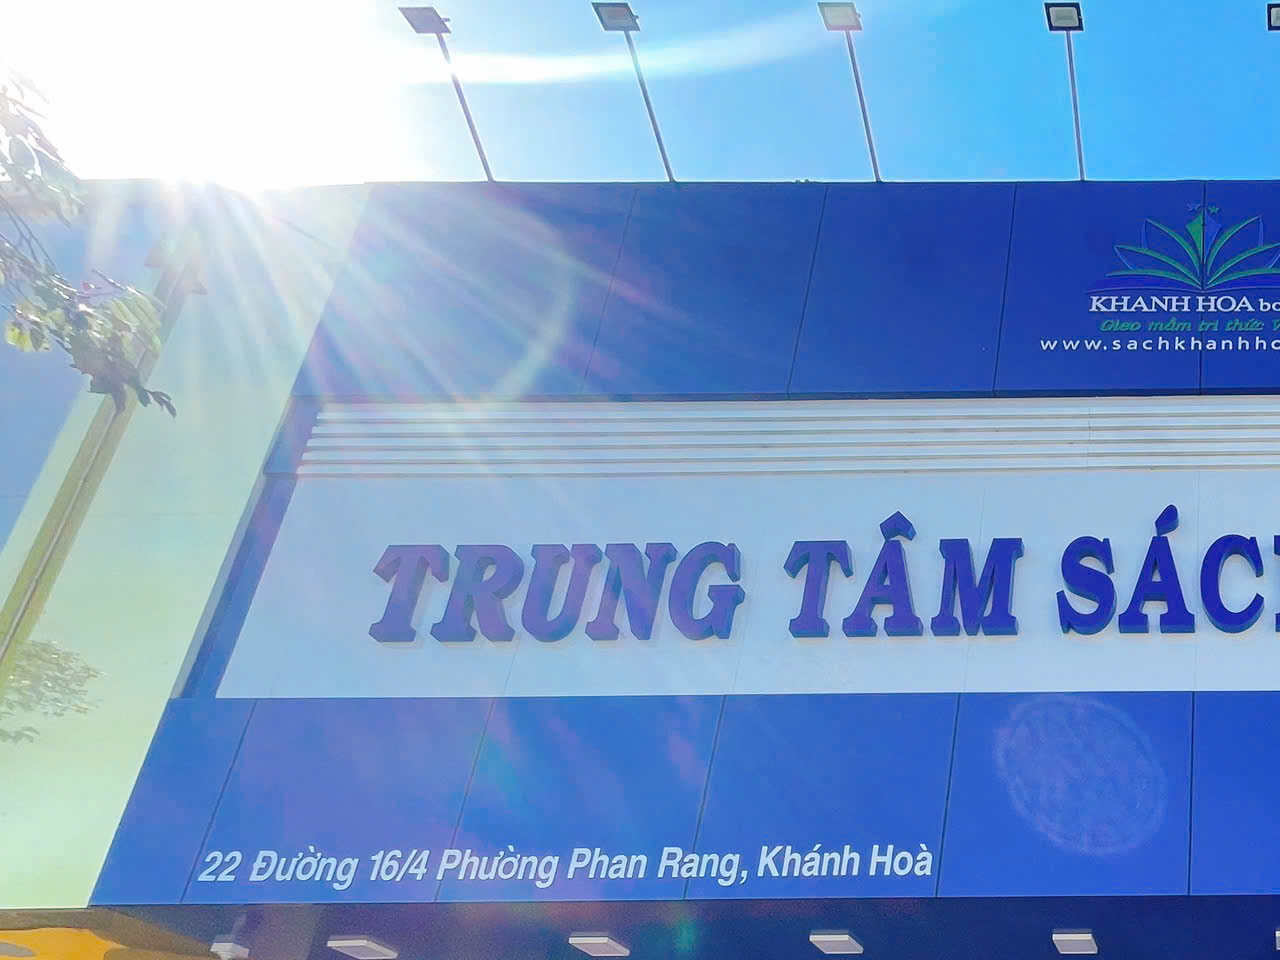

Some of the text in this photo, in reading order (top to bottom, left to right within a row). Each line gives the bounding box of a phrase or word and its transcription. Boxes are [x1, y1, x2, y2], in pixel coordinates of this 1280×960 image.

[1089, 295, 1191, 312] KHANH
[1195, 295, 1255, 312] HOA
[369, 541, 747, 643] TRUNG
[783, 511, 1025, 639] TÂM
[197, 842, 934, 891] 22 Đường 16/4 Phường Phan Rang, Khánh Hoà
